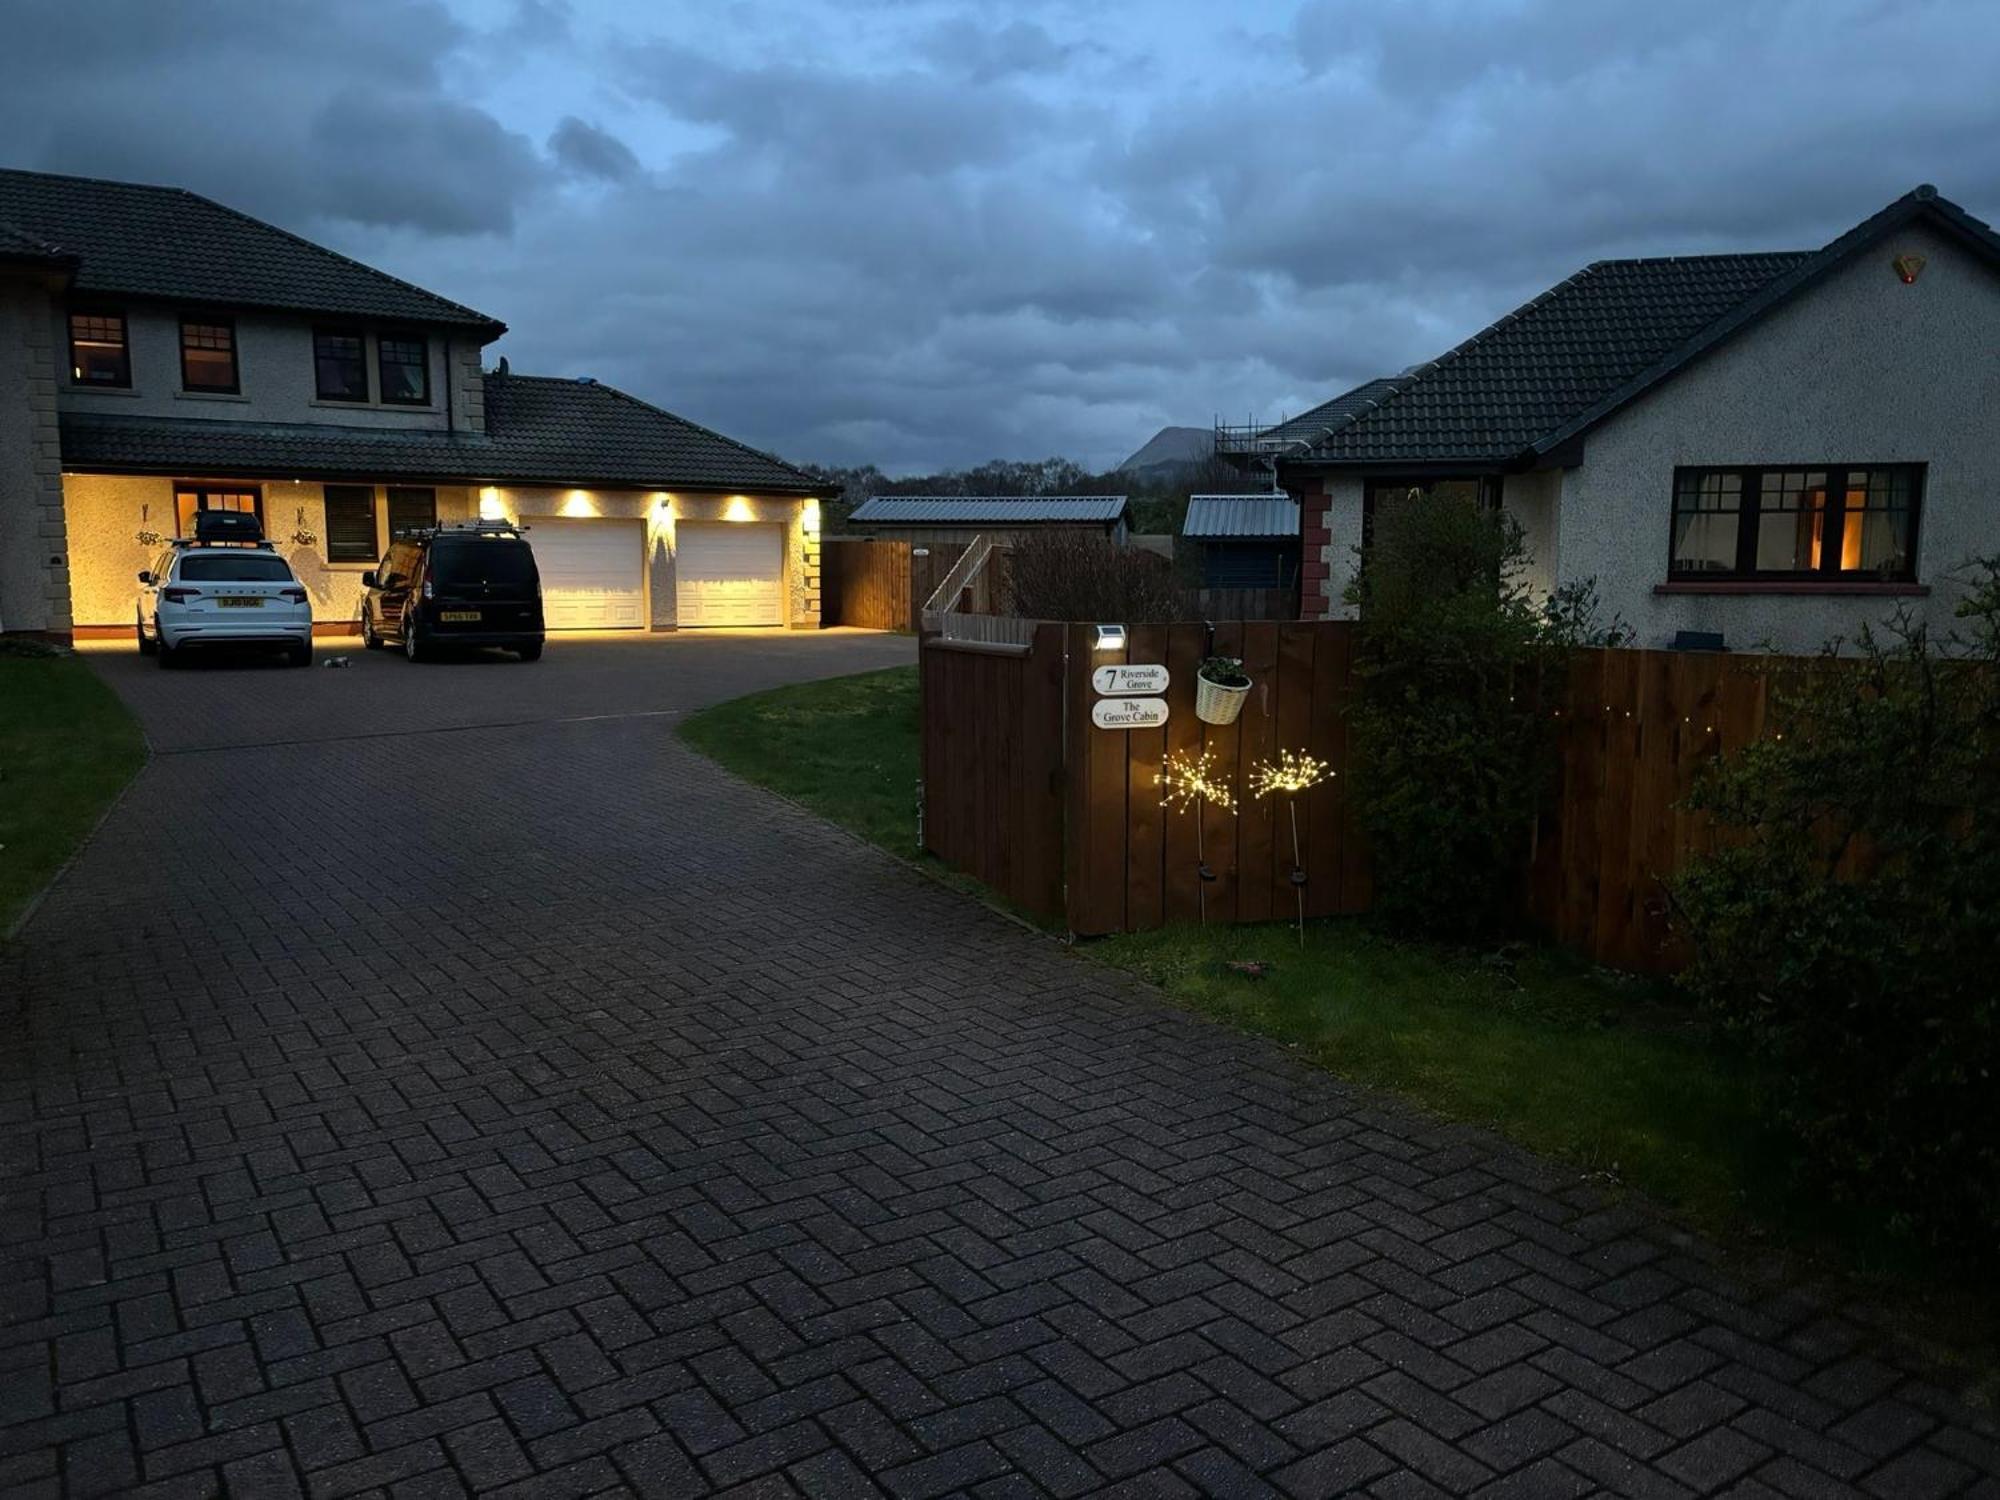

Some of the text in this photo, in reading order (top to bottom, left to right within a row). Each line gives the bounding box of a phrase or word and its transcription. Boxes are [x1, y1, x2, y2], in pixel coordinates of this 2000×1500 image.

[1106, 669, 1159, 689] 7 Riverside
[1126, 680, 1153, 689] Grove
[1123, 702, 1141, 711] The
[1103, 711, 1159, 722] Grove Cabin
